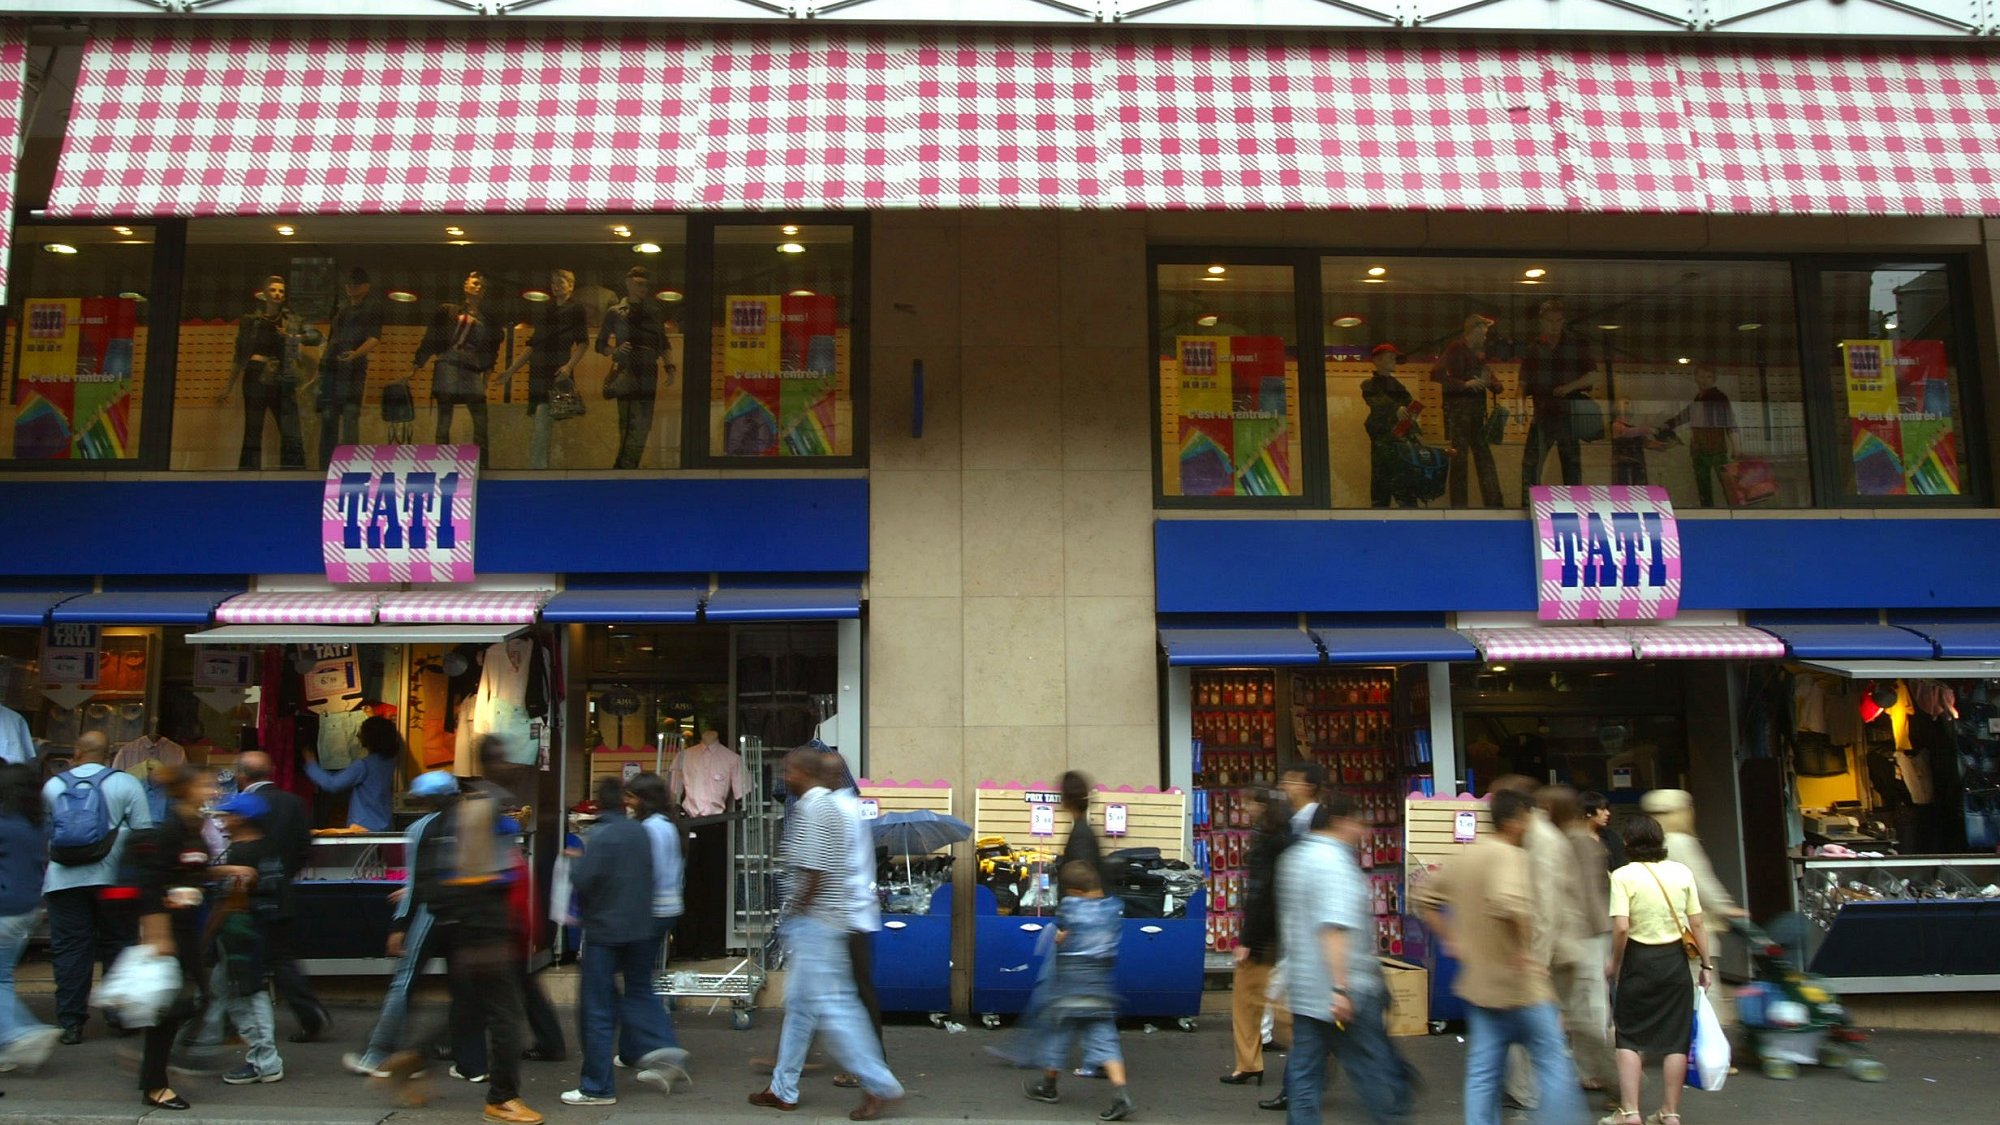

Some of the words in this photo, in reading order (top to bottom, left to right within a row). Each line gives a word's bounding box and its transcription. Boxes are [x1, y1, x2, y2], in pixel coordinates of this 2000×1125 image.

[32, 311, 62, 330] TATI
[735, 309, 762, 326] TATI
[1185, 348, 1212, 367] TATI
[1852, 352, 1878, 370] TATI
[29, 372, 58, 383] C'est
[74, 372, 115, 382] rentrée
[734, 369, 764, 379] C'est
[765, 369, 776, 379] la
[780, 369, 819, 379] rentrée
[1187, 409, 1217, 420] C'est
[1218, 410, 1229, 419] la
[1231, 409, 1272, 419] rentrée
[1858, 410, 1885, 421] C'est
[1898, 410, 1936, 421] rentrée
[338, 472, 459, 549] TATI
[1551, 512, 1667, 587] TATI
[54, 634, 91, 646] TATI
[315, 644, 350, 660] TATI
[1026, 792, 1043, 802] PRIX
[1045, 793, 1062, 803] TATI
